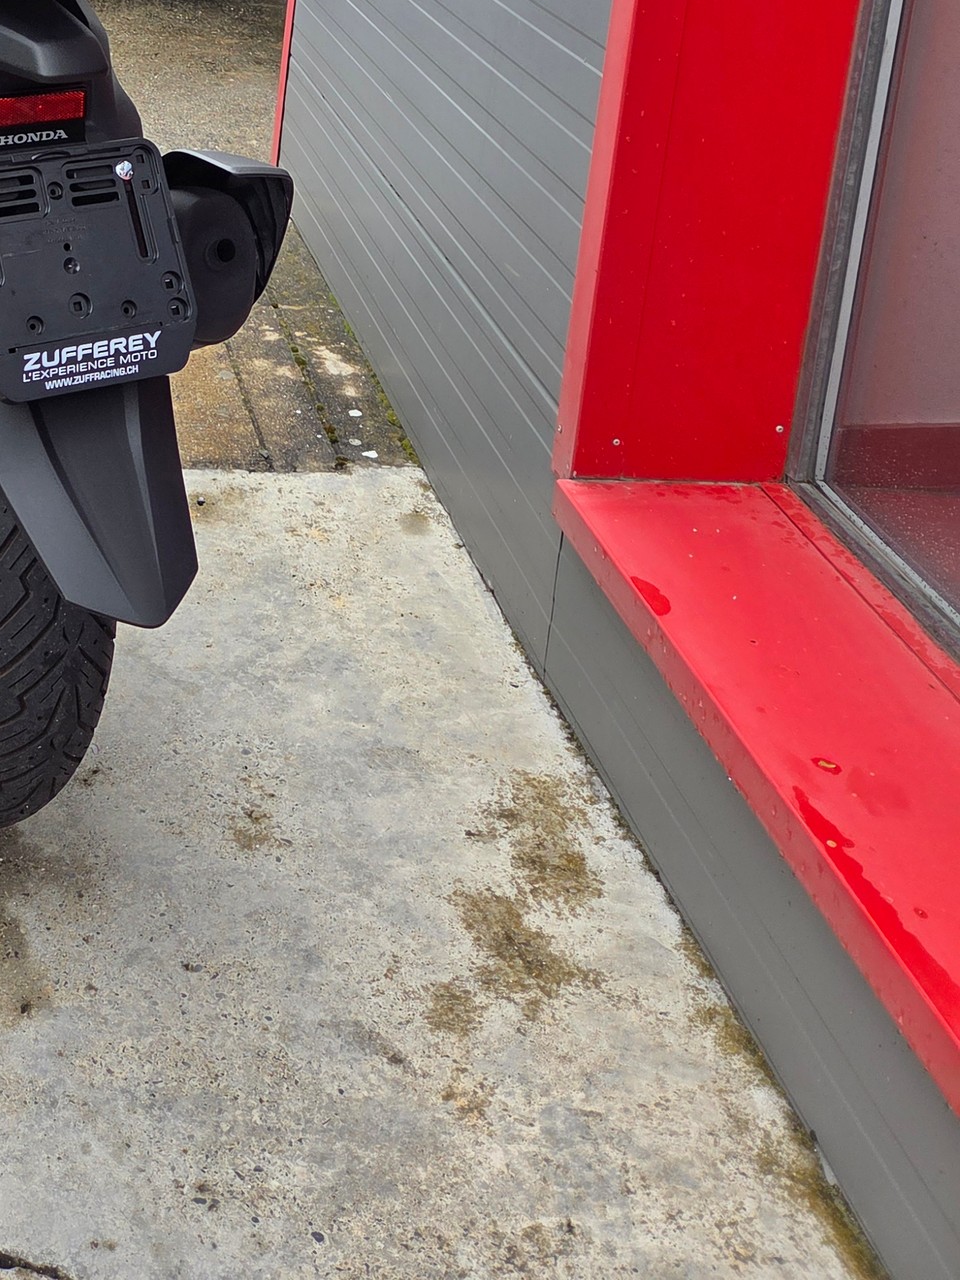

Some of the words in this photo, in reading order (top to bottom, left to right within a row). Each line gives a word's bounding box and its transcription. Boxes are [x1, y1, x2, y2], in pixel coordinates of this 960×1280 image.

[0, 129, 68, 146] HONDA
[23, 330, 162, 371] ZUFFEREY
[22, 357, 115, 383] L'EXPERIENCE
[119, 349, 158, 365] MOTO
[44, 364, 139, 390] WWW.ZUFFRACING.CH
